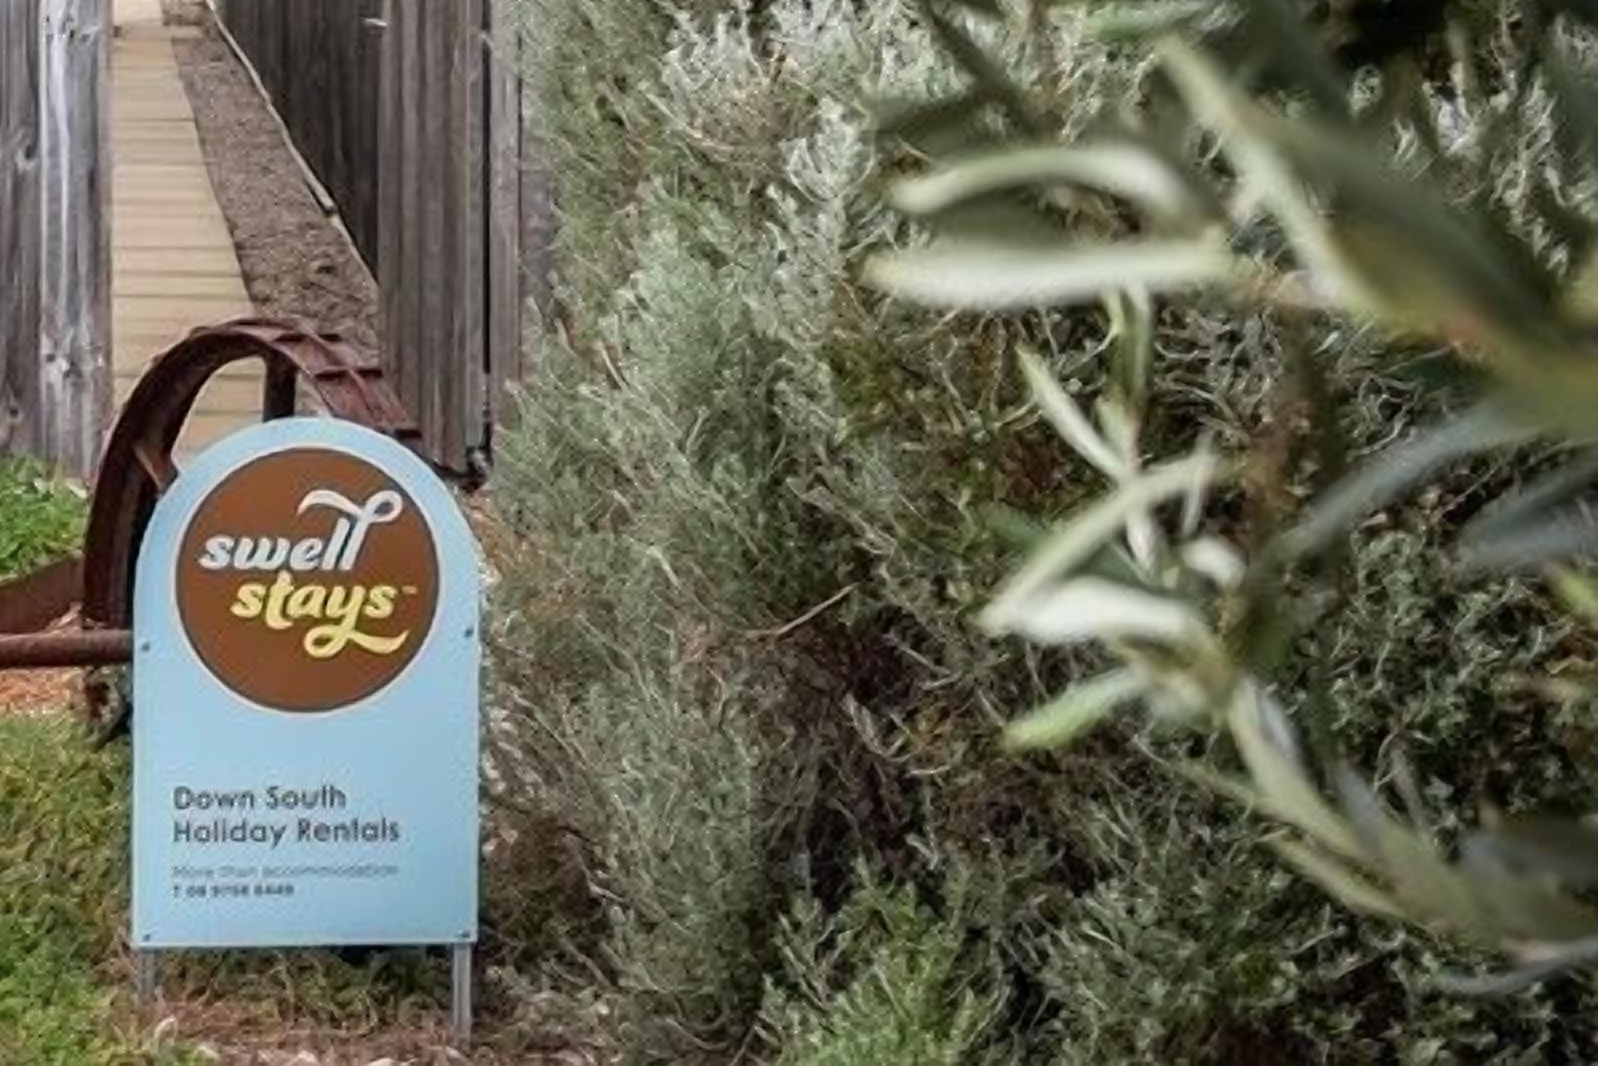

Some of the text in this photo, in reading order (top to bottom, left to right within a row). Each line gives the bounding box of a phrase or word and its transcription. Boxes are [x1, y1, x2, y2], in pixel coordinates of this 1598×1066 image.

[199, 490, 402, 571] swell
[230, 570, 410, 658] stays
[173, 784, 347, 810] Down South
[173, 817, 400, 849] Holiday Rentals
